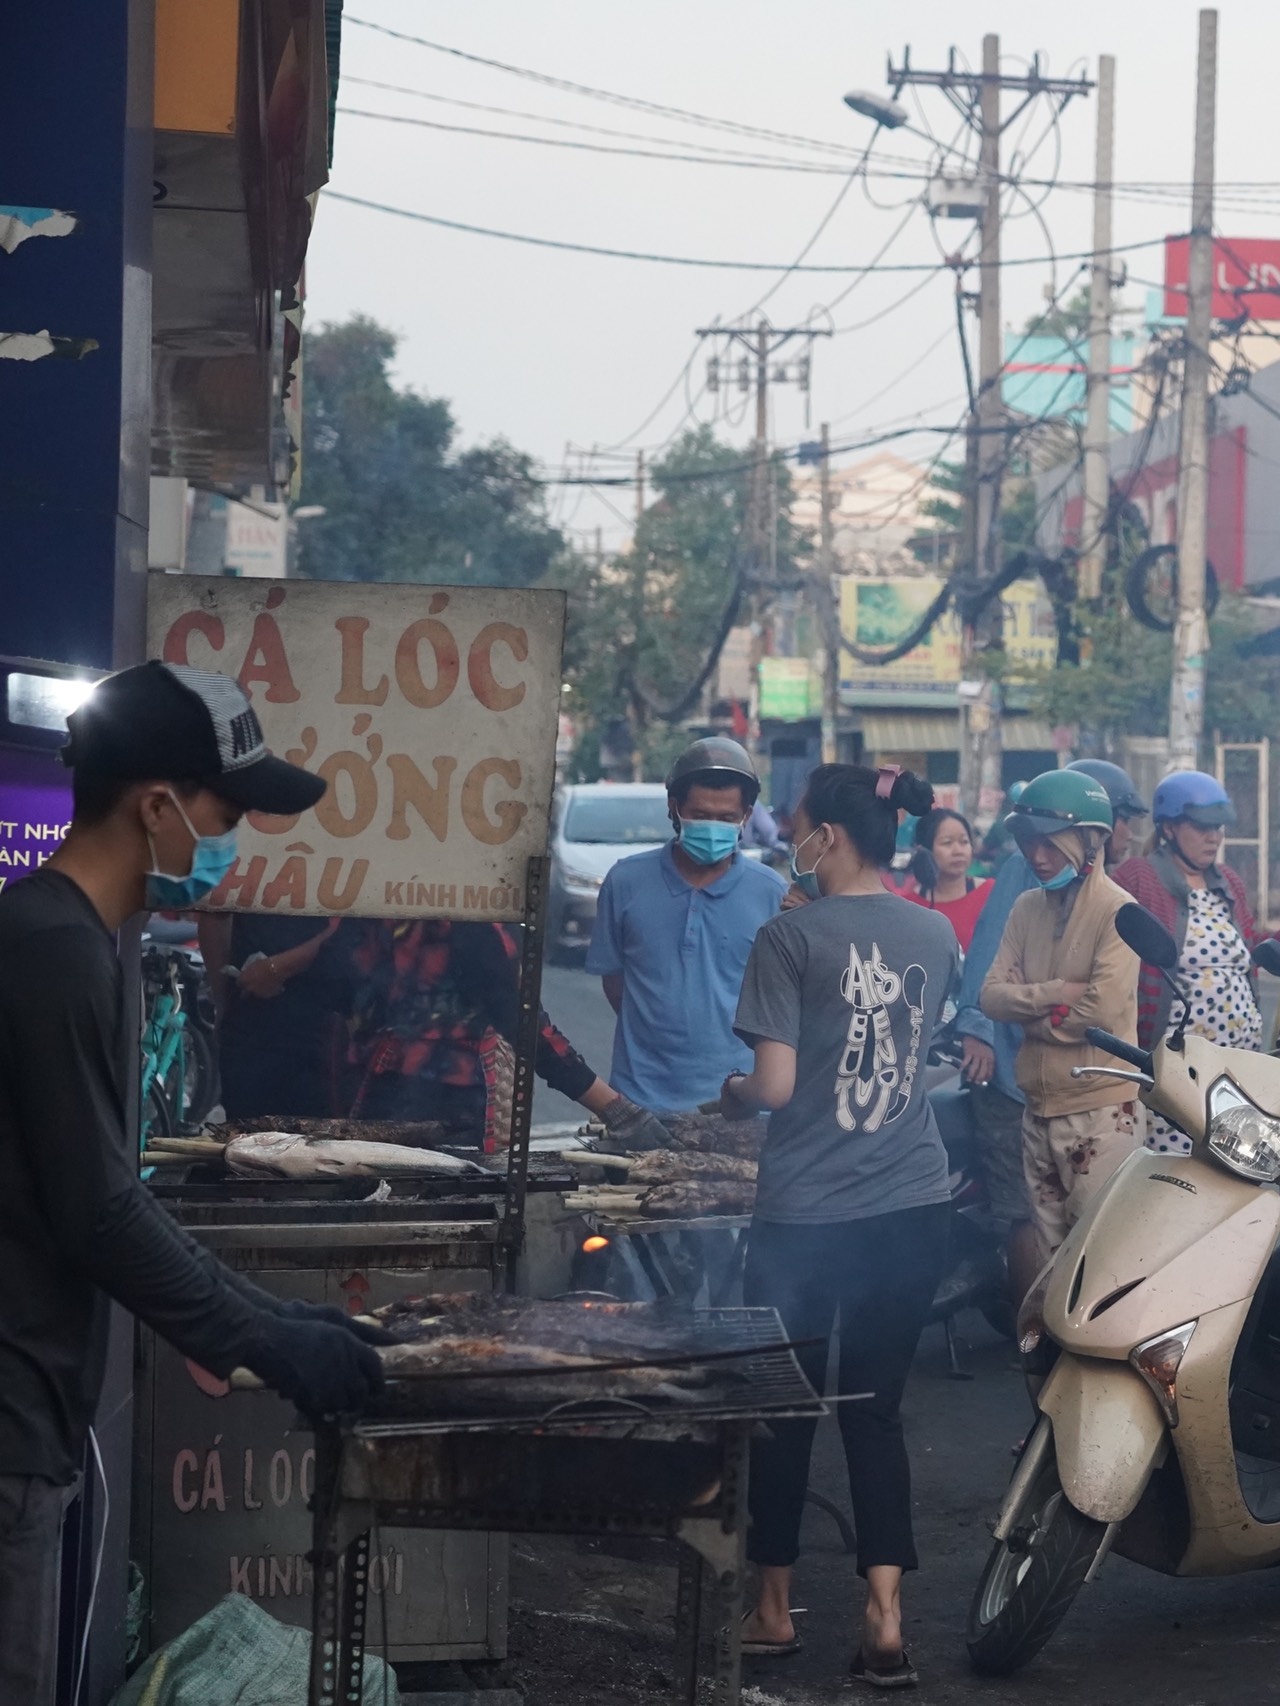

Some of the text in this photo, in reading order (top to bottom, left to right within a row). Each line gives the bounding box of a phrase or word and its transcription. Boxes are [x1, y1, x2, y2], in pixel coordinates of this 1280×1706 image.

[333, 592, 529, 712] LÓC
[384, 874, 457, 908] KÍNH
[172, 1433, 226, 1514] CÁ
